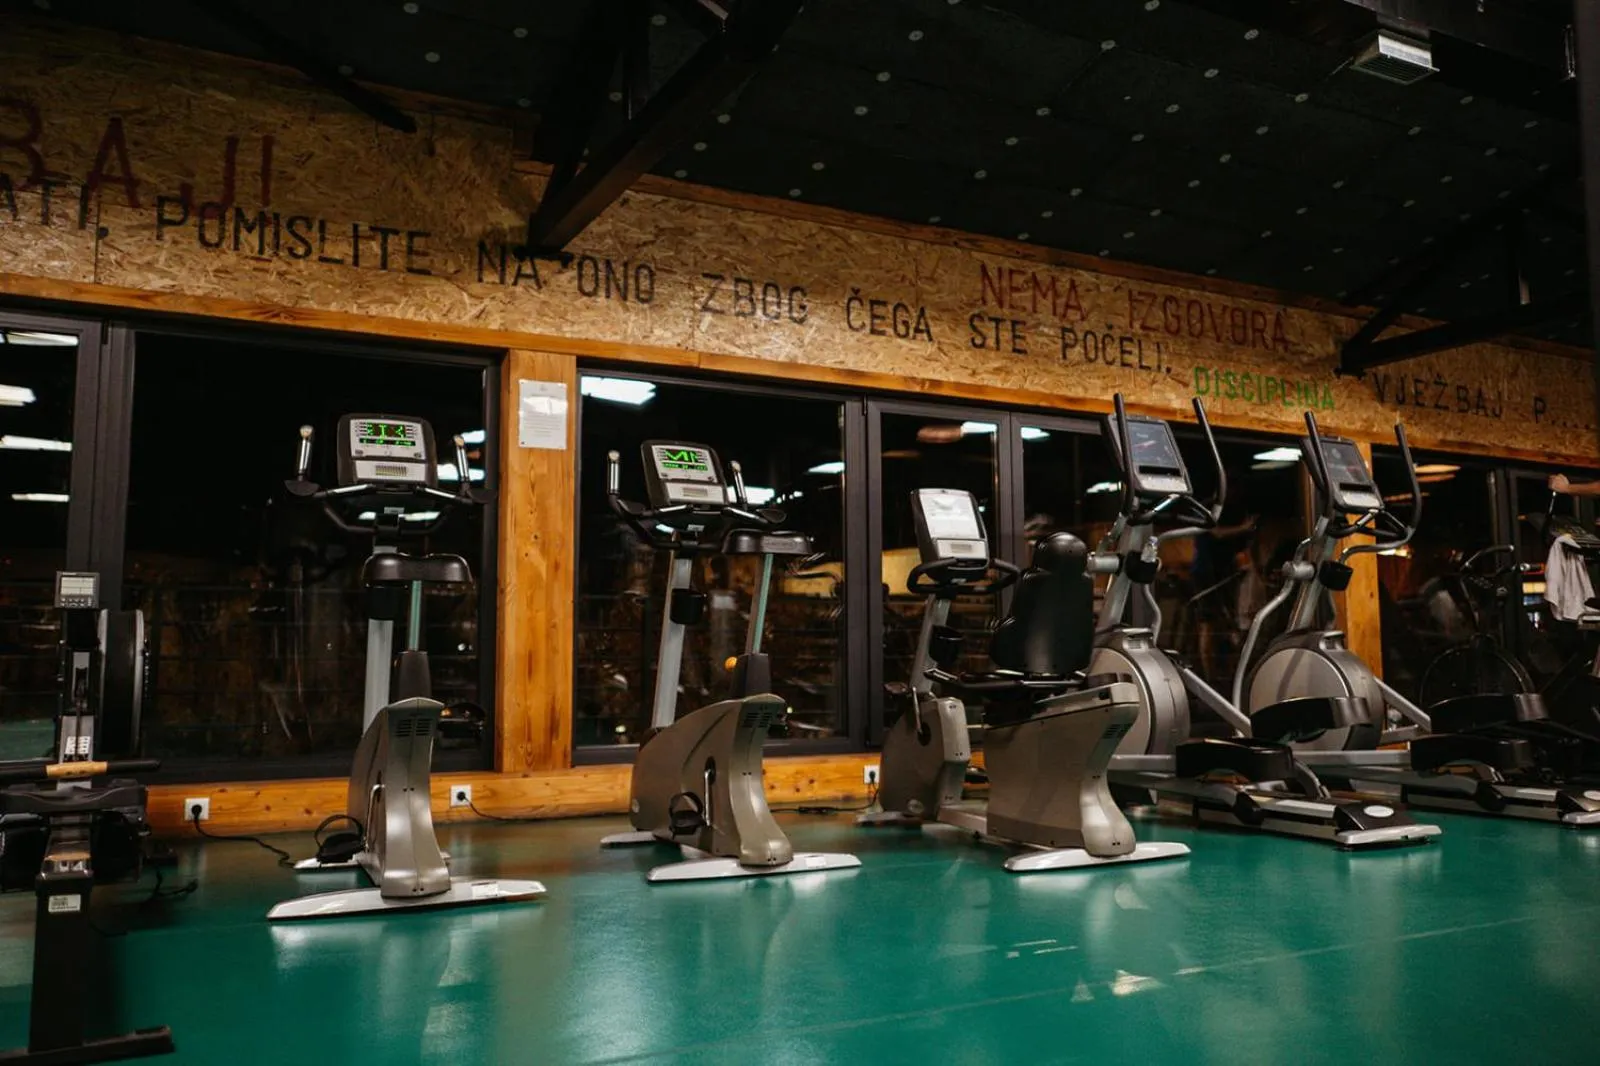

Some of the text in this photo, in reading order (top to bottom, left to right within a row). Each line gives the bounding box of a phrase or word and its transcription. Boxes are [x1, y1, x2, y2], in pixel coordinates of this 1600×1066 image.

[155, 194, 432, 276] POMISLITE
[477, 240, 543, 289] NA
[577, 254, 656, 304] ONO
[701, 271, 809, 324] ZBOG
[846, 288, 934, 342] ČEGA
[970, 313, 1028, 355] STE
[1061, 323, 1172, 375] POČELI.
[980, 263, 1291, 351] NEMA IZGOVORA
[1194, 366, 1336, 411] DISCIPLINA
[1372, 372, 1504, 418] VJEŽBAJ
